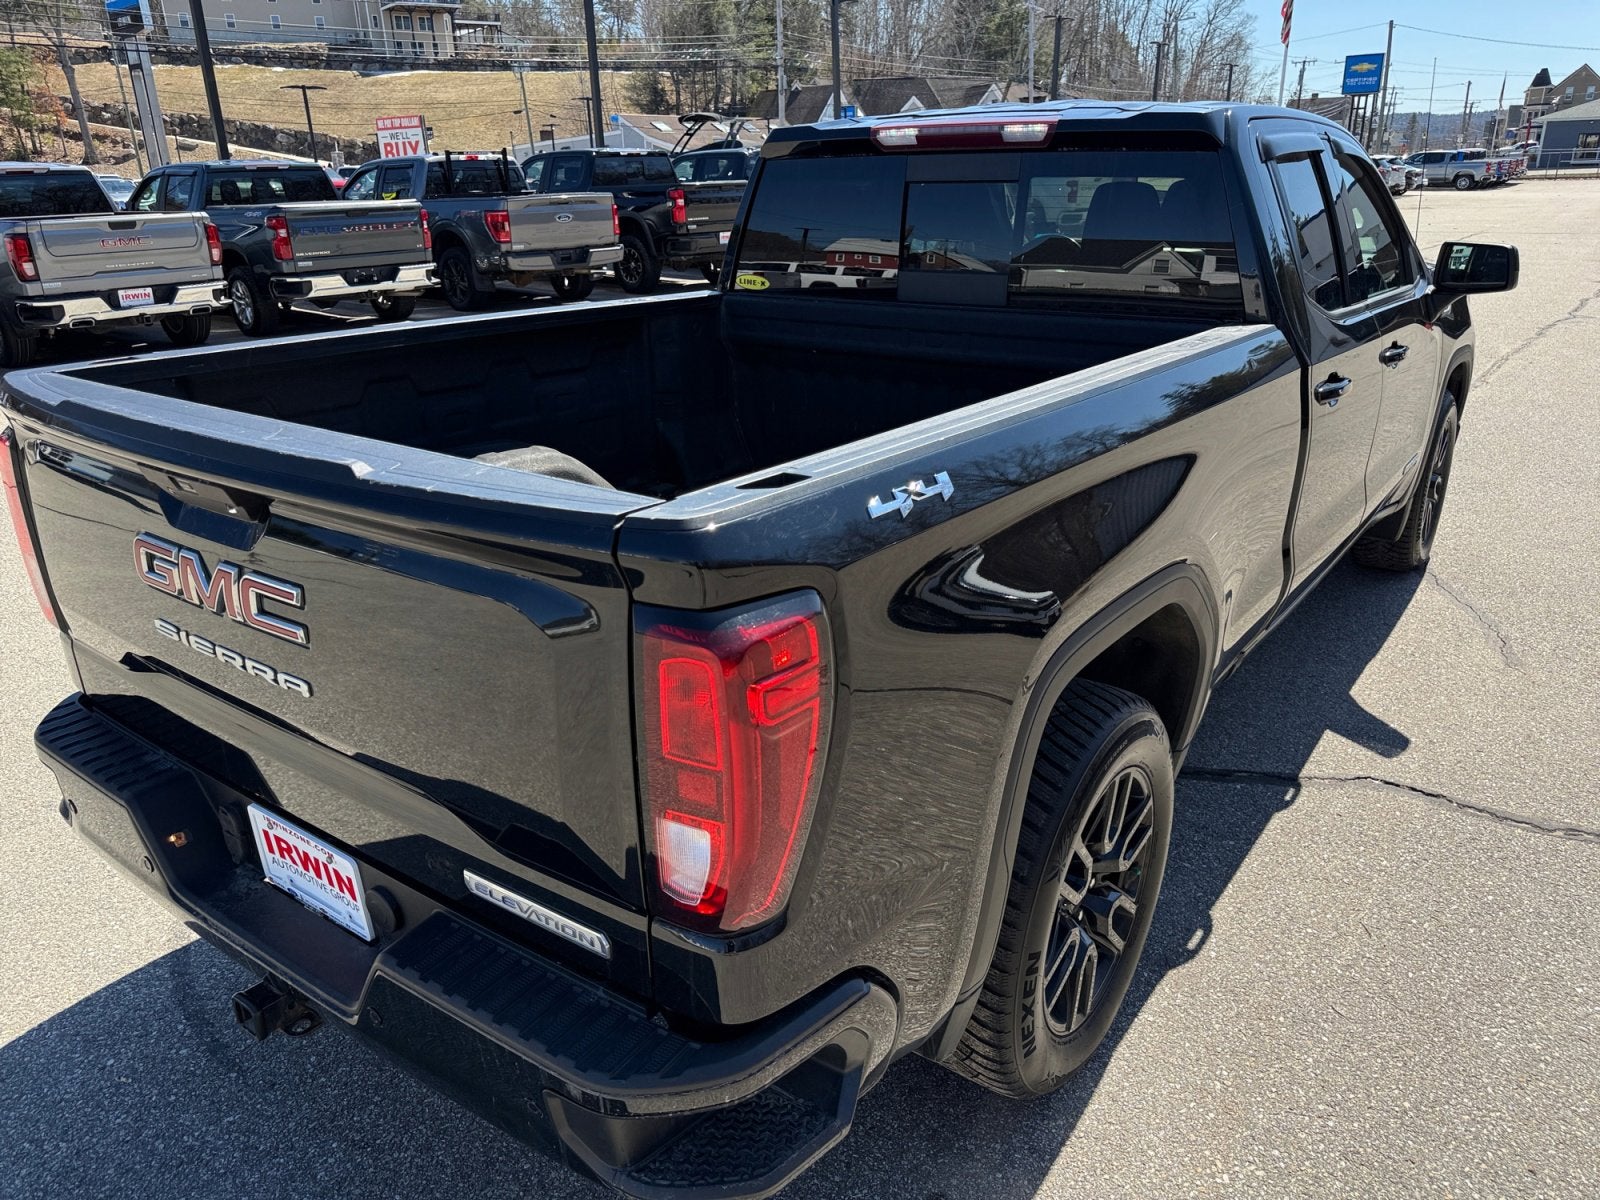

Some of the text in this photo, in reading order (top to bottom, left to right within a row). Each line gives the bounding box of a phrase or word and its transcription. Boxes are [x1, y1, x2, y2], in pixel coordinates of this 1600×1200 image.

[384, 140, 420, 158] BUY
[389, 132, 410, 140] WE'LL
[100, 235, 151, 249] GMC
[300, 222, 414, 236] CHEVROLET
[121, 292, 151, 302] IRWIN
[739, 278, 767, 287] LINE-X
[133, 531, 310, 649] GMC
[154, 618, 314, 698] SIERRA
[262, 829, 357, 902] IRWIN
[272, 857, 330, 895] AUTOMOTIVE
[330, 889, 360, 913] GROUP
[475, 881, 596, 948] ELEVATION
[1021, 951, 1042, 1059] NEXEN
